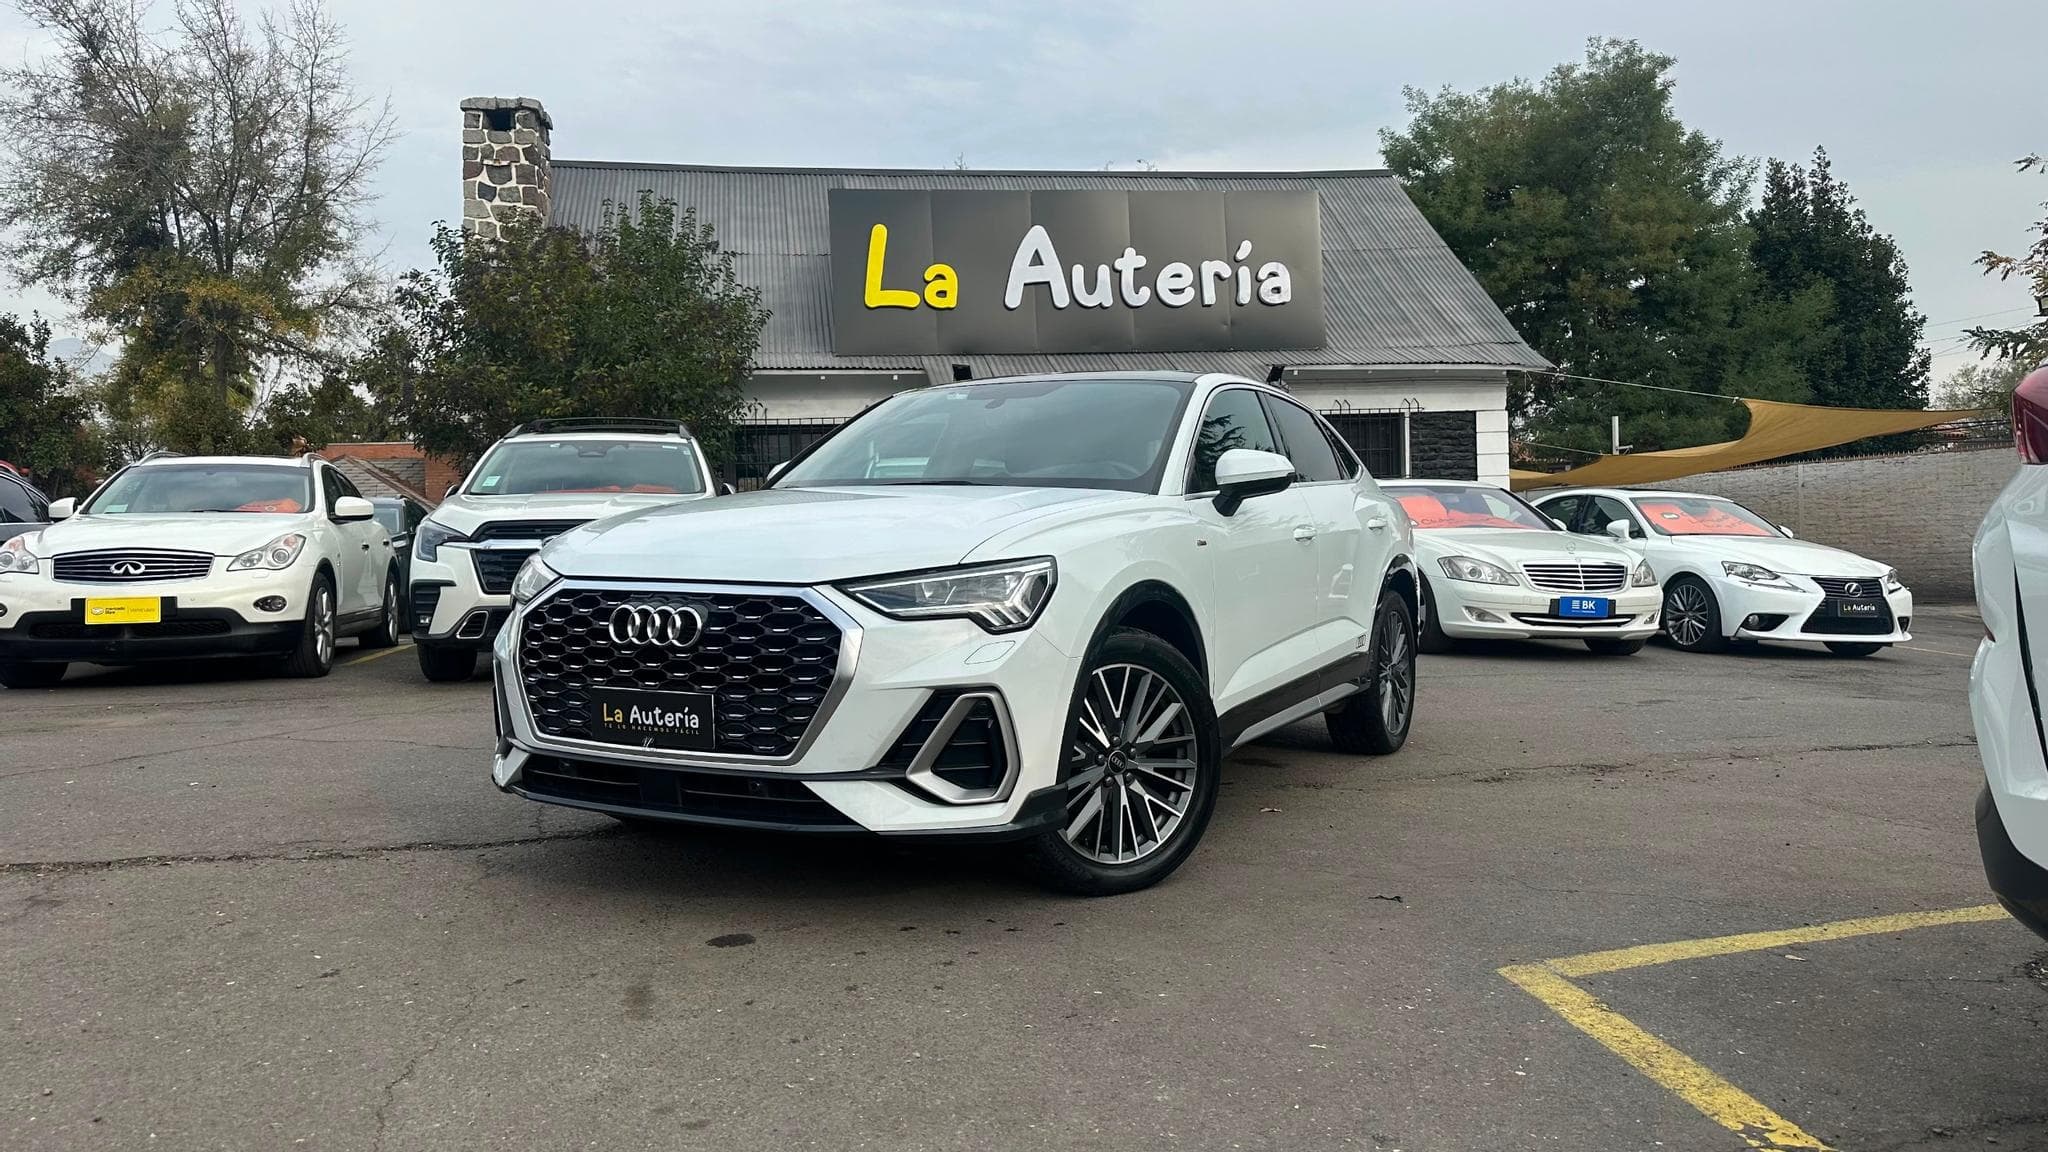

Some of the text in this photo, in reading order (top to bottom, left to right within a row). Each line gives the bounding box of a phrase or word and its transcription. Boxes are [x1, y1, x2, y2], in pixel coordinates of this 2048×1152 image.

[864, 224, 1292, 310] La Autería
[1582, 600, 1596, 610] BK
[603, 702, 699, 729] La Autería
